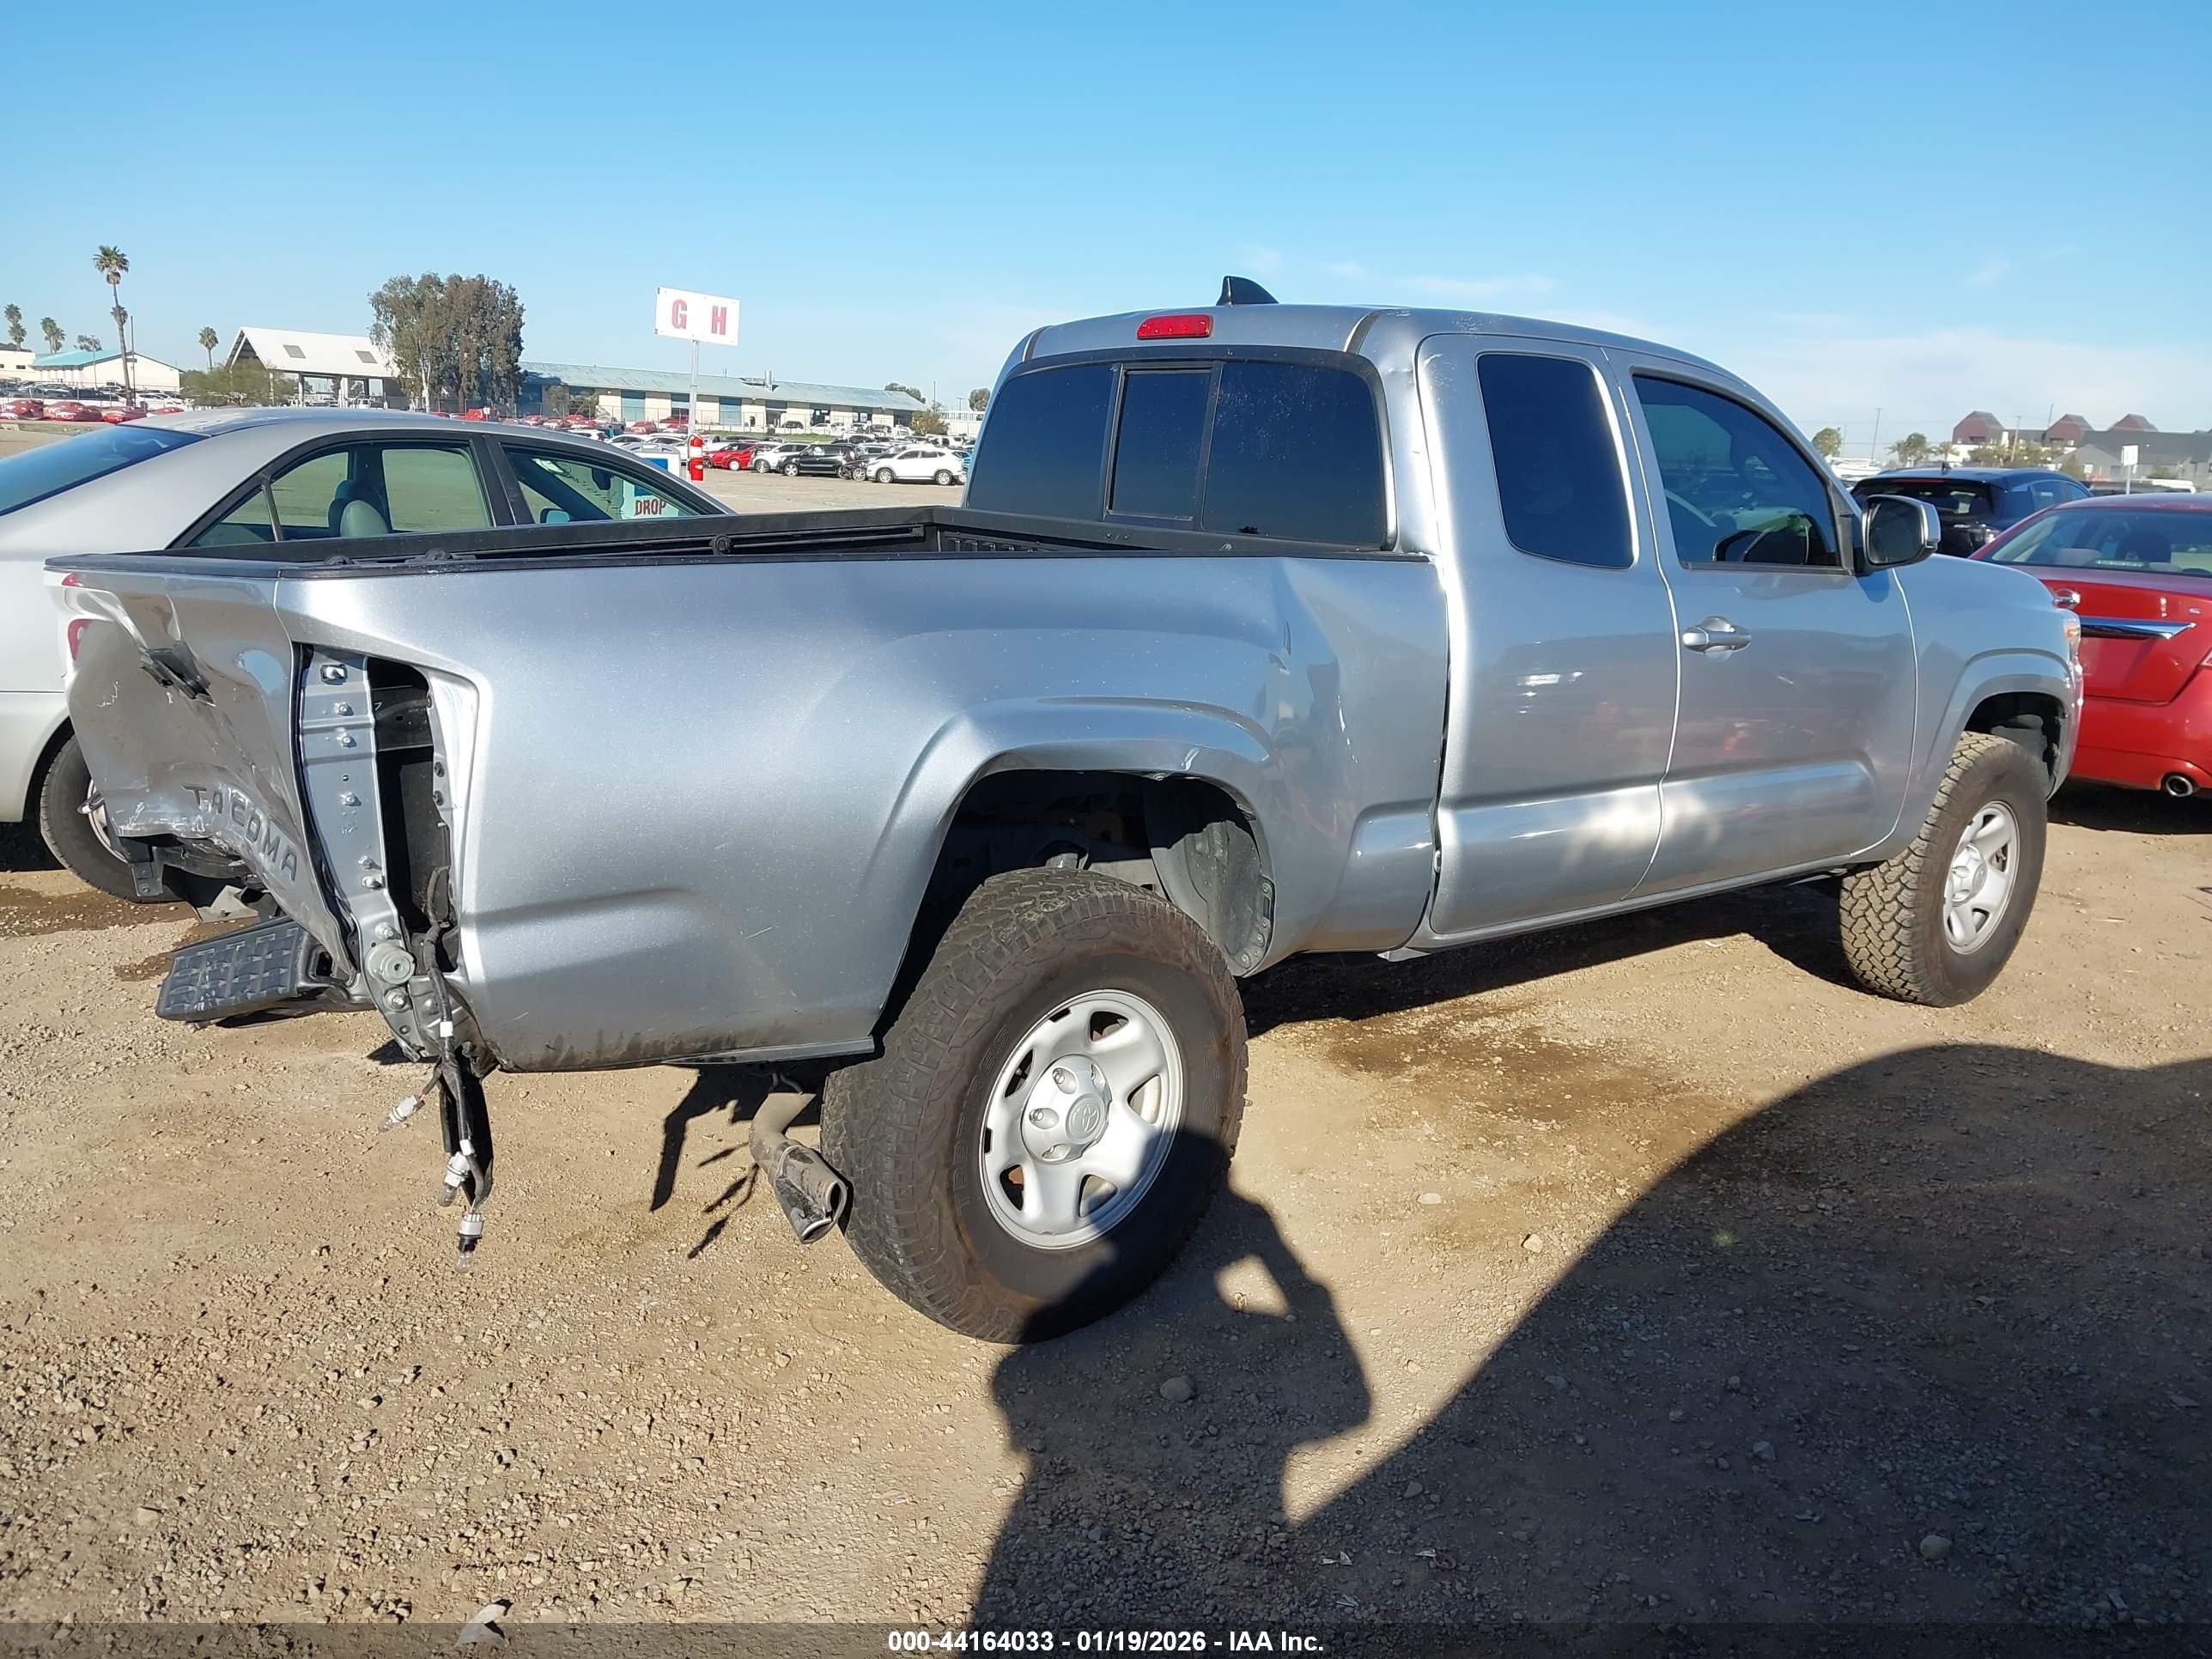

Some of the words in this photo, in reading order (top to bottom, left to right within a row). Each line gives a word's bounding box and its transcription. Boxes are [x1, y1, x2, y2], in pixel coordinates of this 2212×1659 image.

[672, 299, 687, 330] G
[711, 305, 727, 336] H
[635, 498, 667, 516] DROP
